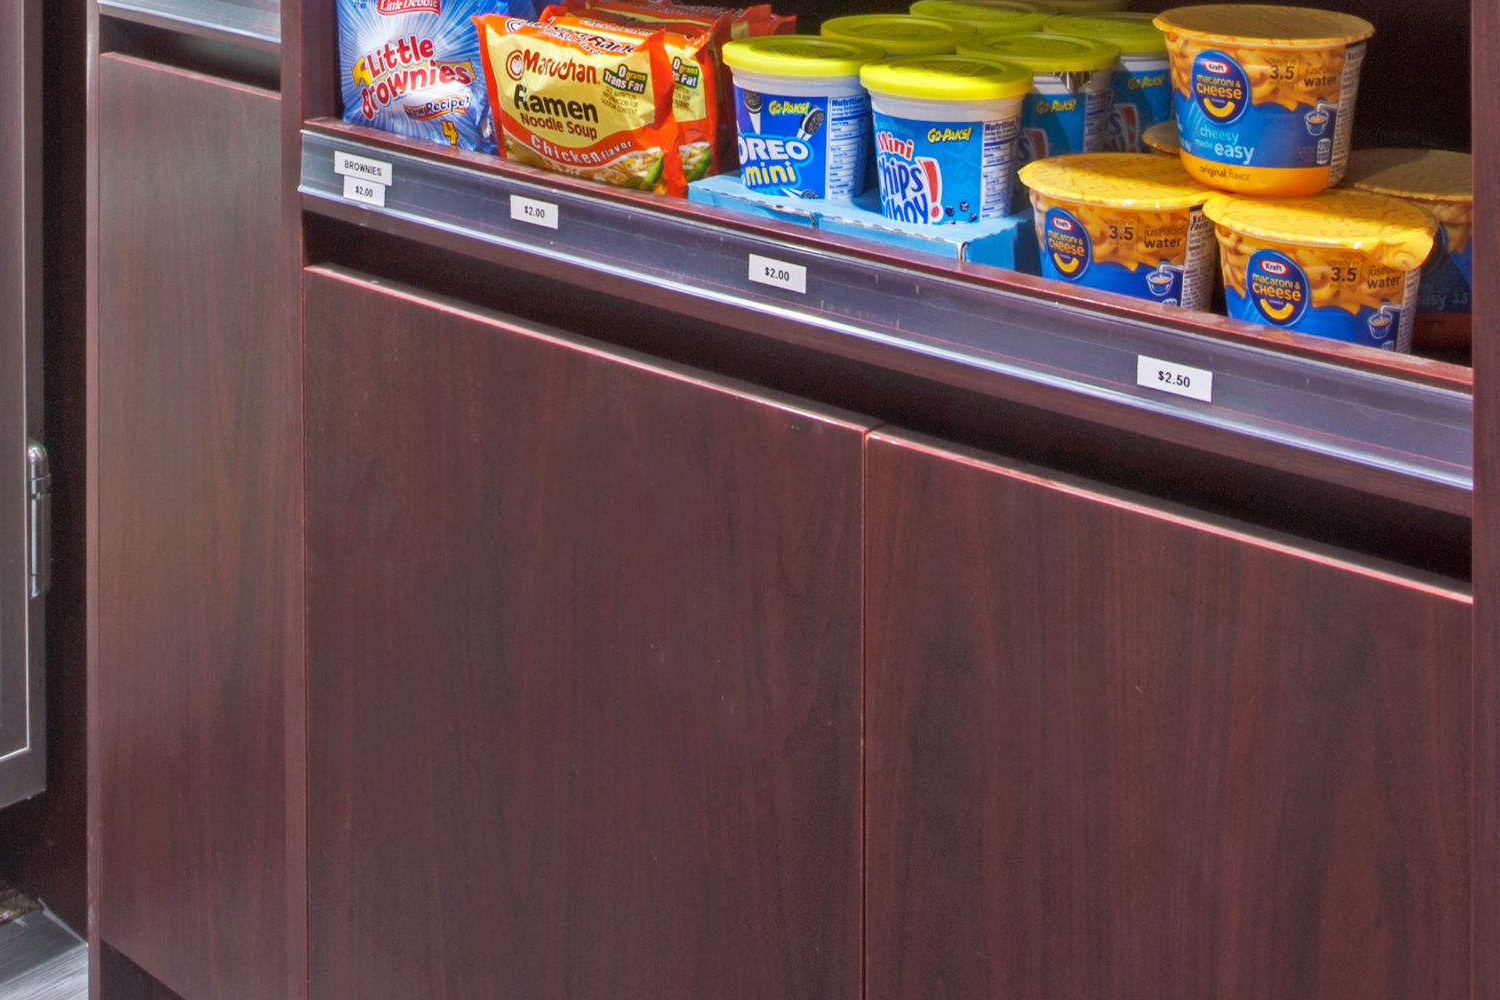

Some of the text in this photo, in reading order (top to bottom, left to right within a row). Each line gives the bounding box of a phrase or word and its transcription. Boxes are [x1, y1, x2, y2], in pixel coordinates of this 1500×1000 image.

[367, 35, 434, 79] Little
[672, 57, 681, 70] 0
[523, 48, 597, 85] Maruchan
[618, 65, 646, 82] 0 grams
[1269, 65, 1295, 80] 3.5
[604, 70, 645, 92] Trans Fat
[1196, 74, 1234, 88] macaroni
[1304, 75, 1338, 88] water
[361, 59, 472, 120] Brownies
[425, 96, 470, 112] Recipe!
[514, 83, 599, 124] Ramen
[520, 113, 598, 141] Noodle Soup
[1200, 125, 1240, 143] cheesy
[531, 133, 632, 165] Chicken Flavor
[876, 132, 914, 160] Mini
[1214, 141, 1255, 165] easy
[344, 159, 382, 177] BROWNIES
[745, 161, 797, 187] mini
[1199, 166, 1227, 180] original
[355, 185, 374, 198] $2.00
[524, 205, 546, 218] $2.00
[1108, 225, 1134, 241] 3.5
[1144, 236, 1183, 249] water
[764, 266, 791, 282] $2.00
[1264, 262, 1283, 273] Kraft
[1330, 267, 1358, 282] 3.5
[1252, 273, 1294, 289] macaroni
[1366, 275, 1402, 290] water
[1157, 370, 1191, 389] $2.50
